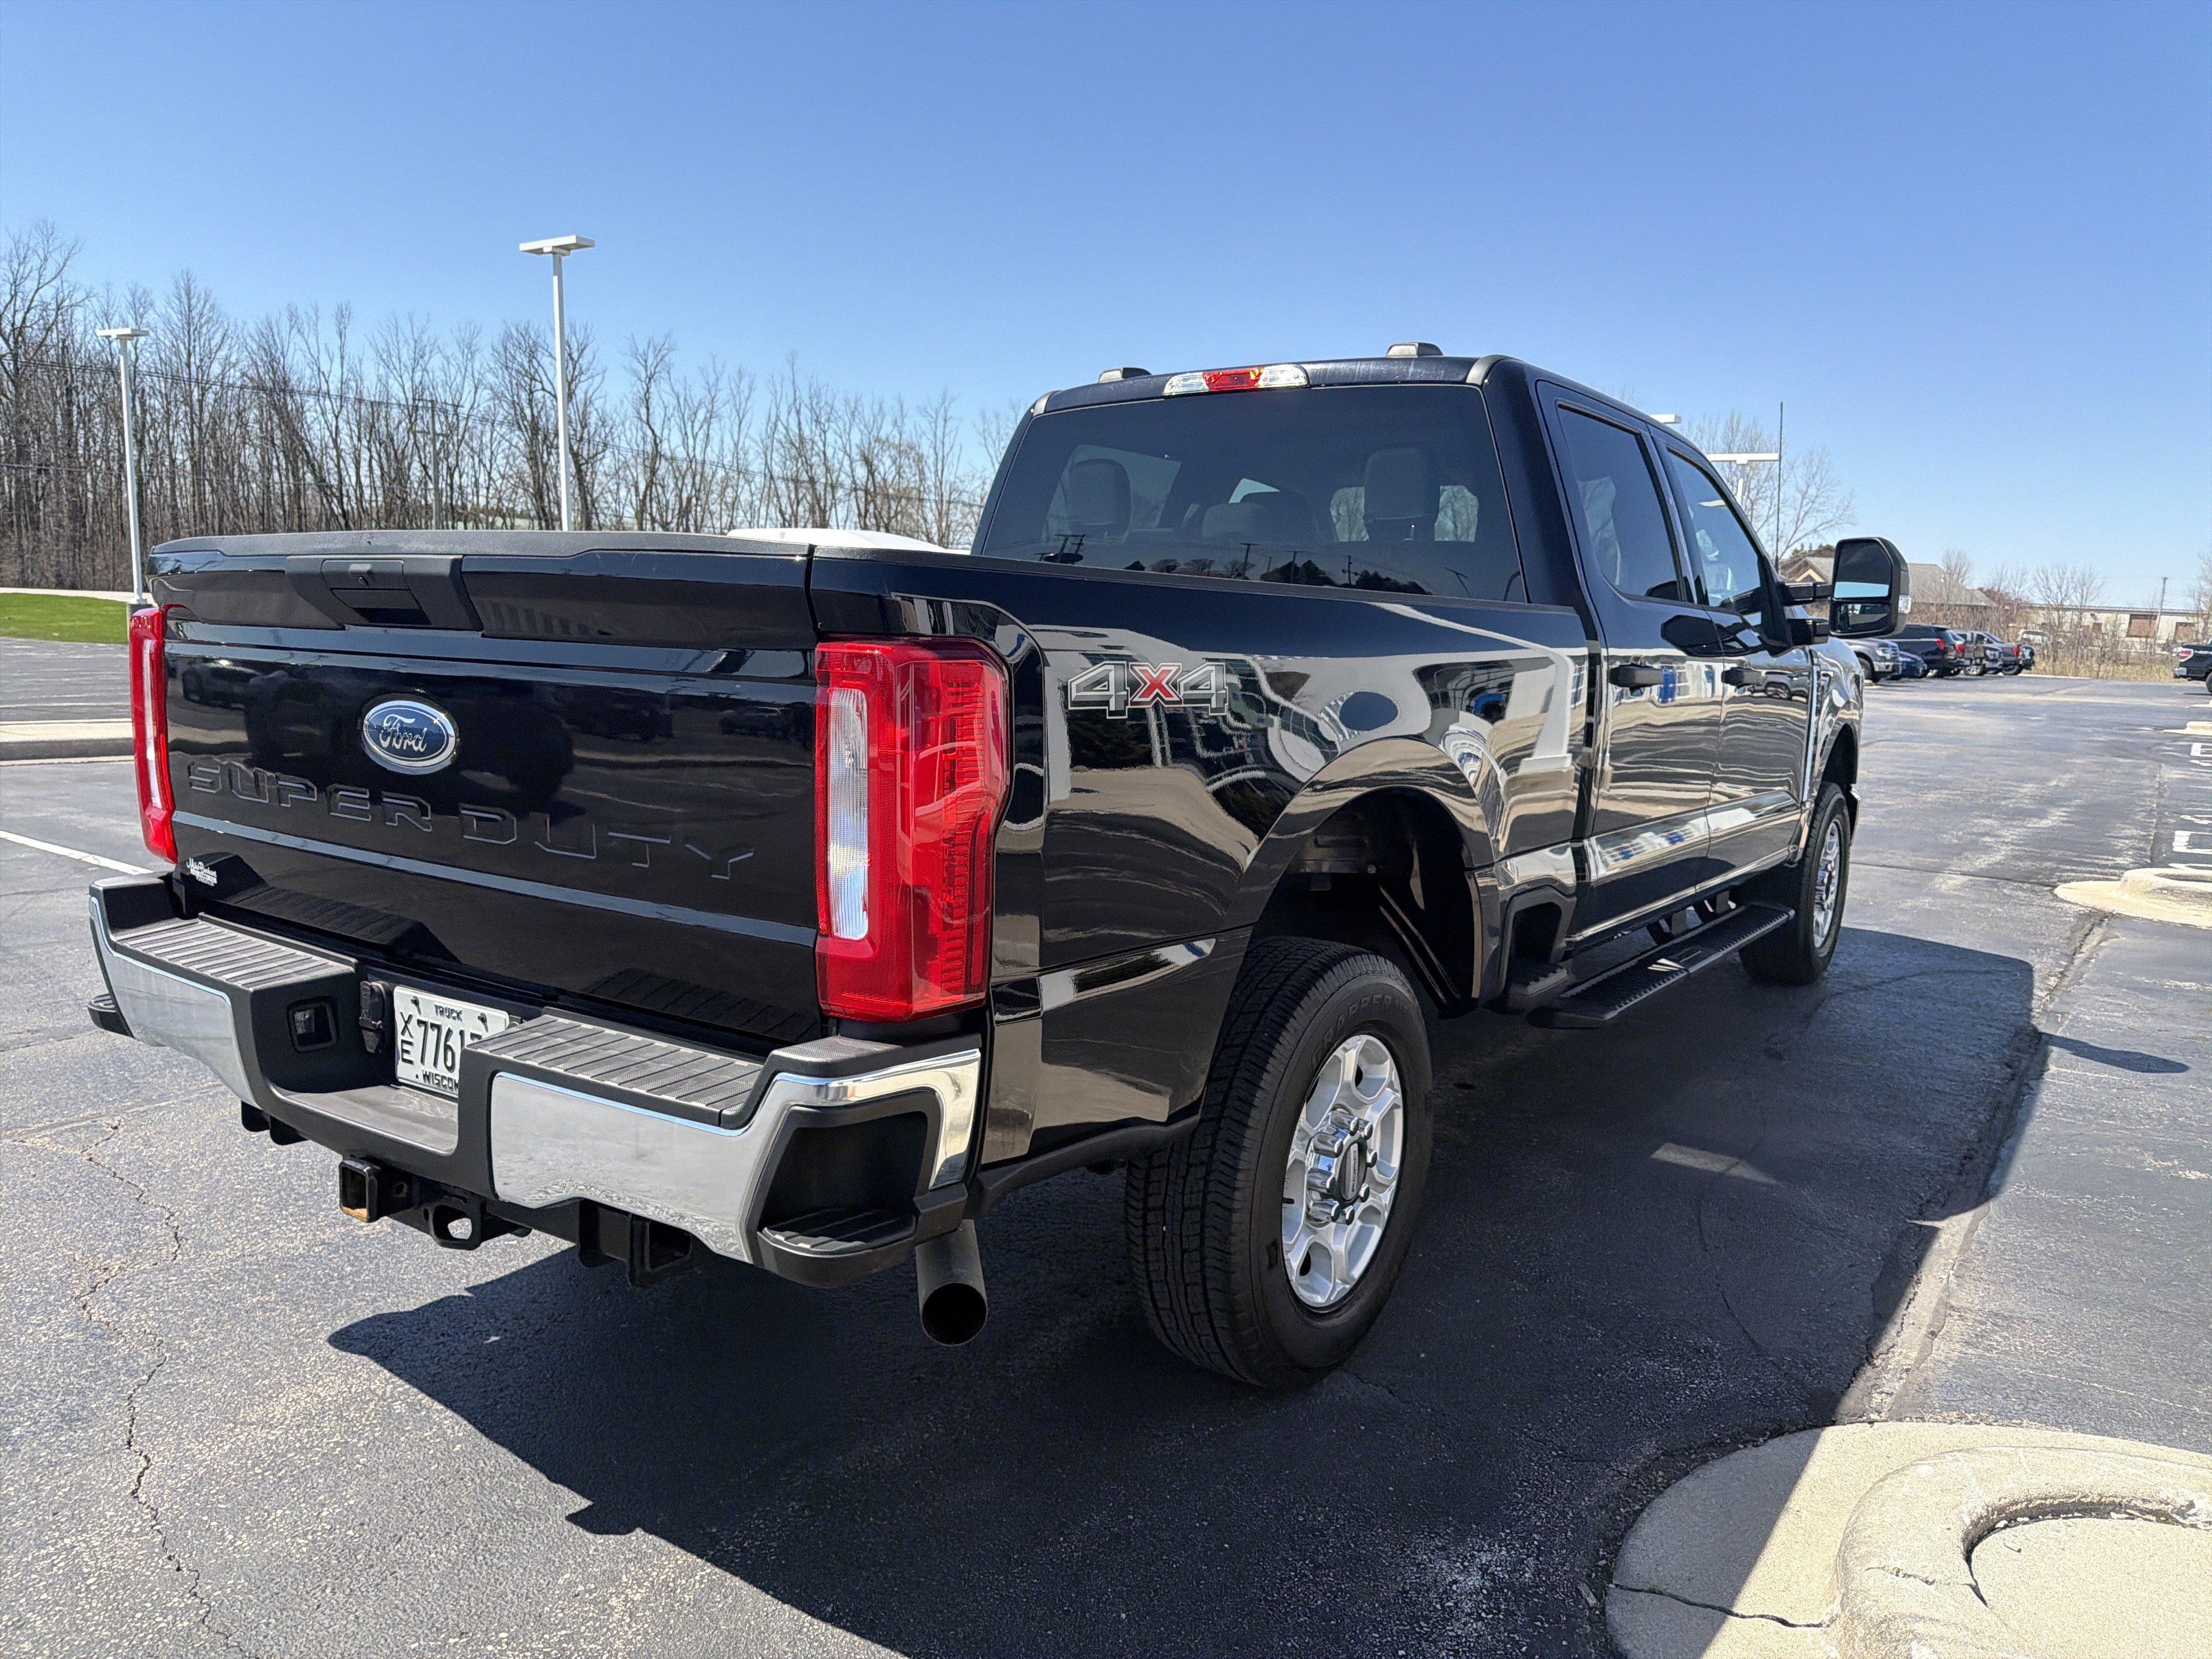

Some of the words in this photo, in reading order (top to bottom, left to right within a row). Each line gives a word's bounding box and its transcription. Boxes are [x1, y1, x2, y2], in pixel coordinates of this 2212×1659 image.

[379, 714, 427, 752] Ford
[188, 761, 432, 832] SUPER
[459, 803, 754, 880] DUTY
[433, 1003, 462, 1022] TRUCK
[417, 1018, 482, 1074] 7761
